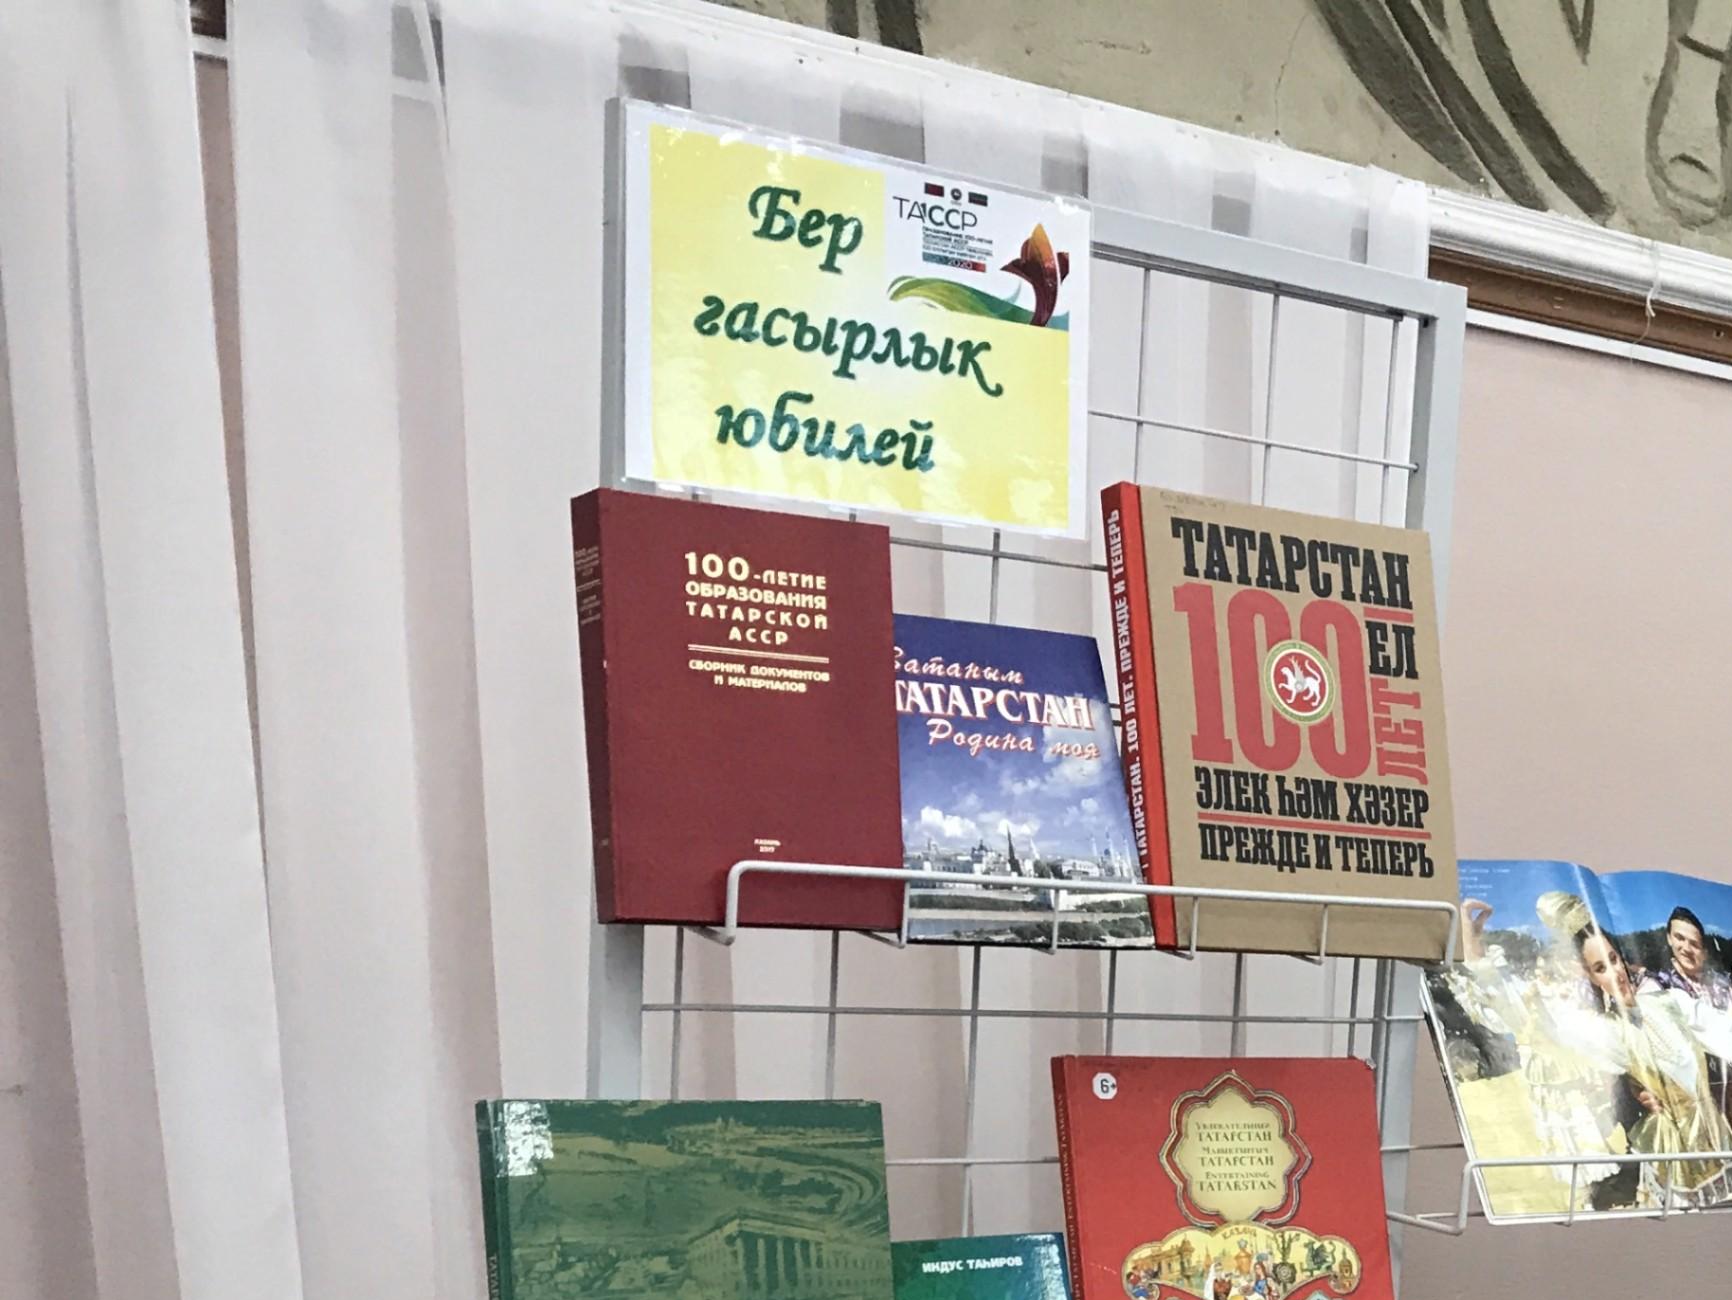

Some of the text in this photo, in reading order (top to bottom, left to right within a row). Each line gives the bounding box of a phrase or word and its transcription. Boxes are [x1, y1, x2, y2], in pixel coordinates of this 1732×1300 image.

[748, 185, 864, 275] Бер
[693, 295, 1004, 397] гасырлык
[715, 391, 936, 472] юбилей
[1107, 509, 1124, 578] ТЕПЕРЬ
[1170, 516, 1414, 611] ТАТАРСТАН
[685, 580, 827, 610] ОБРАЗОВАНИЯ
[685, 601, 828, 630] ТАТАРСКОЙ
[728, 626, 788, 645] АССР
[1116, 596, 1134, 670] ПРЕЖДЕ
[1365, 620, 1420, 680] ЕЛ
[688, 659, 830, 682] СБОРНИК ДОКУМЕНТОВ
[728, 676, 807, 693] МАТЕРИАЛОВ
[1172, 581, 1373, 780] 100
[927, 718, 1101, 760] Родина моя
[1369, 678, 1429, 786] ЛЕТ
[1194, 766, 1273, 816] ЭЛЕК
[1346, 784, 1430, 830] ХӘЗЕР
[1198, 823, 1436, 879] ПРЕЖДЕ И ТЕПЕРЬ
[1099, 1078, 1117, 1095] 6+
[1197, 1131, 1272, 1142] ТАТАРСТАН
[1198, 1155, 1274, 1167] ТАТАРСТАН
[1197, 1180, 1277, 1192] TATARSTAN
[922, 1258, 964, 1273] ИНДУС
